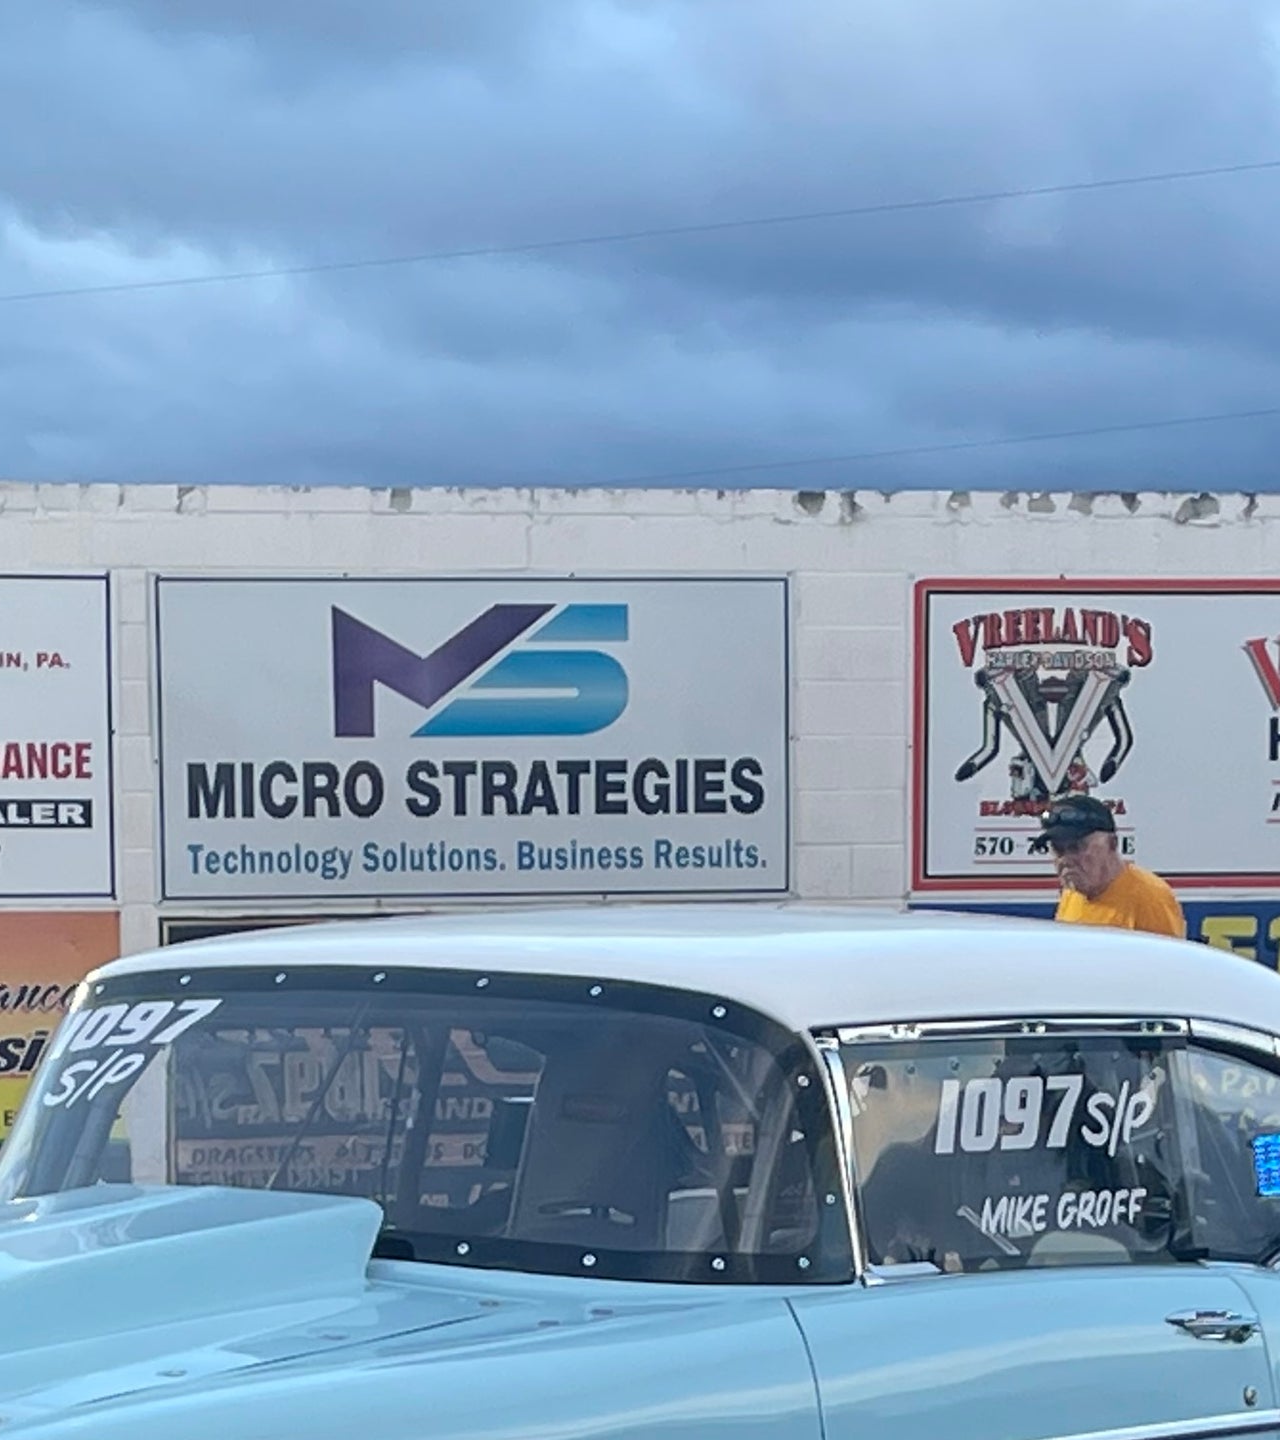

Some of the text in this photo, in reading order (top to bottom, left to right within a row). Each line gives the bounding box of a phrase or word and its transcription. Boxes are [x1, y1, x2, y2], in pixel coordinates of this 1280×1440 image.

[36, 651, 71, 668] PA.
[953, 607, 1153, 667] VREELAND'S
[985, 651, 1118, 670] HARLEY-DAVIDSON
[186, 757, 767, 819] MICRO STRATEGIES
[186, 838, 768, 880] Technology Solutions. Business Results.
[42, 1048, 146, 1109] S/P
[933, 1074, 1155, 1157] 1097 S/P
[981, 1188, 1148, 1236] MIKE GROFF
